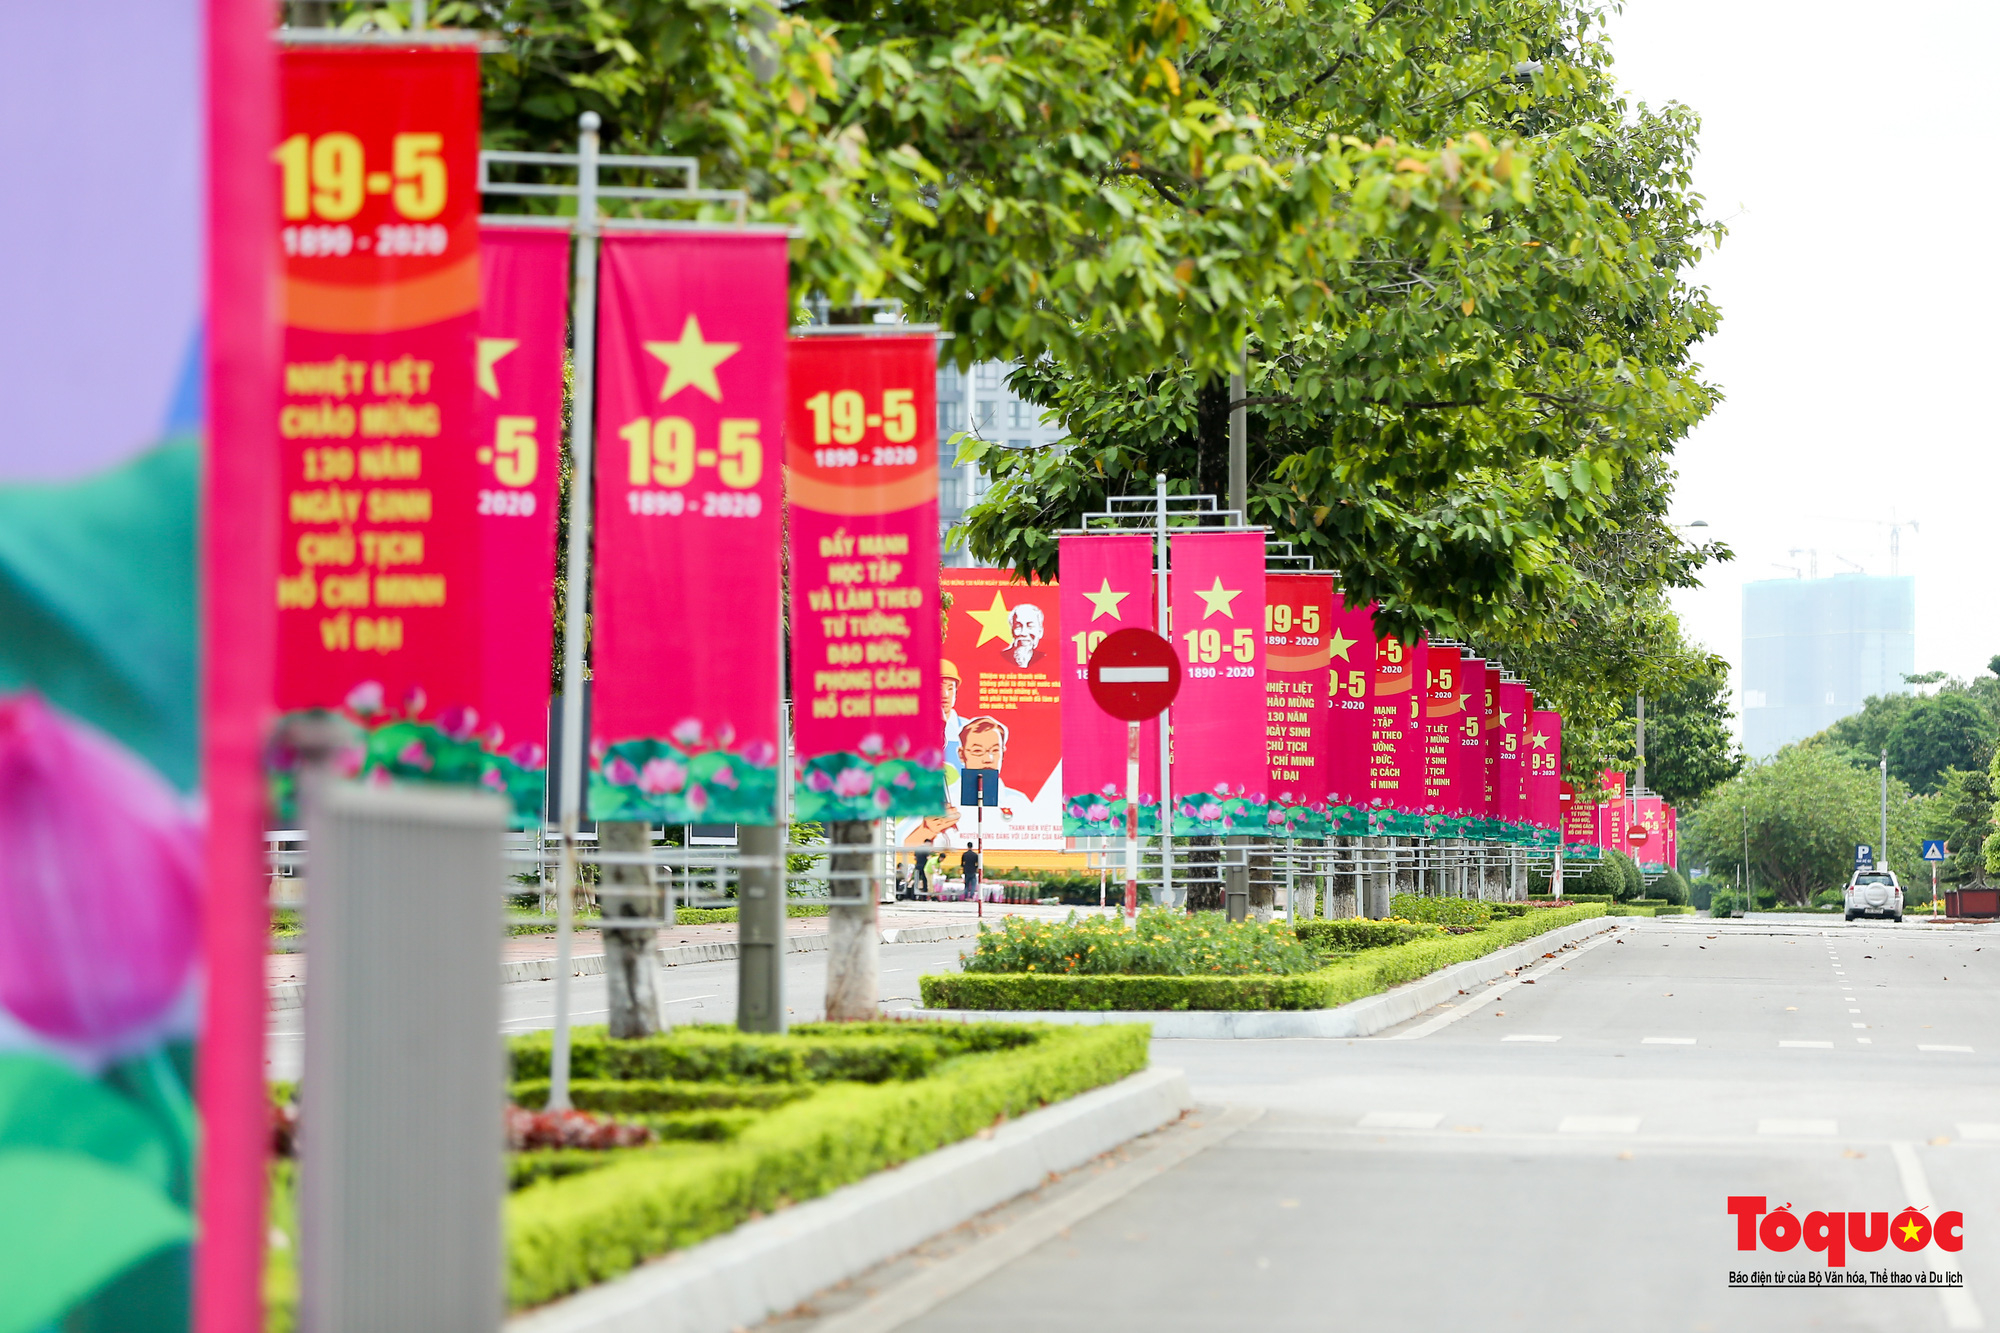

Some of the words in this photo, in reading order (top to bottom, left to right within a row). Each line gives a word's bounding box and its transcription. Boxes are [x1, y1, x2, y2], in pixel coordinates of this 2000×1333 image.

[271, 131, 447, 221] 19-5
[376, 224, 447, 257] 2020
[805, 389, 917, 445] 19-5
[477, 415, 539, 487] -5
[618, 415, 762, 489] 19-5
[814, 447, 858, 467] 1890
[872, 446, 918, 465] 2020
[477, 490, 536, 516] 2020
[627, 490, 684, 516] 1890
[702, 492, 761, 518] 2020
[858, 534, 908, 560] MẠNH
[829, 563, 864, 588] HỌC
[808, 585, 833, 611] VÀ
[836, 585, 874, 611] LÀM
[877, 588, 923, 609] THEO
[1265, 604, 1320, 634] 19-5
[1183, 628, 1255, 664] 19-5
[1295, 636, 1319, 646] 2020
[827, 643, 862, 668] ĐẠO
[1379, 639, 1402, 663] -5
[814, 671, 872, 692] PHONG
[875, 665, 920, 689] CÁCH
[1076, 669, 1088, 680] 18
[1188, 667, 1216, 679] 1890
[1226, 666, 1255, 678] 2020
[1293, 681, 1313, 695] LIỆT
[1329, 669, 1366, 698] 9-5
[813, 692, 839, 718] HỒ
[842, 693, 871, 717] CHÍ
[874, 696, 919, 716] MINH
[1267, 695, 1286, 707] HÀO
[1288, 696, 1315, 708] MỪNG
[1342, 701, 1365, 710] 2020
[1267, 712, 1284, 722] 130
[1287, 711, 1307, 722] NĂM
[1374, 706, 1397, 717] MẠNH
[1377, 717, 1393, 729] TẬP
[1433, 724, 1448, 734] LIỆT
[1460, 717, 1479, 737] -5
[1289, 727, 1311, 737] SINH
[1381, 731, 1402, 740] THEO
[1430, 734, 1449, 743] MỪNG
[1286, 741, 1307, 753] TỊCH
[1430, 745, 1445, 754] NĂM
[1500, 733, 1516, 752] -5
[1273, 754, 1288, 766] CHÍ
[1291, 756, 1315, 766] MINH
[1376, 755, 1394, 765] ĐỨC,
[1532, 753, 1555, 769] 9-5
[1272, 768, 1282, 780] VĨ
[1283, 771, 1299, 782] ĐẠI
[1379, 766, 1400, 777] CÁCH
[1430, 767, 1445, 776] TỊCH
[1379, 780, 1399, 789] MINH
[1428, 788, 1439, 797] ĐẠI
[1858, 846, 1869, 859] P
